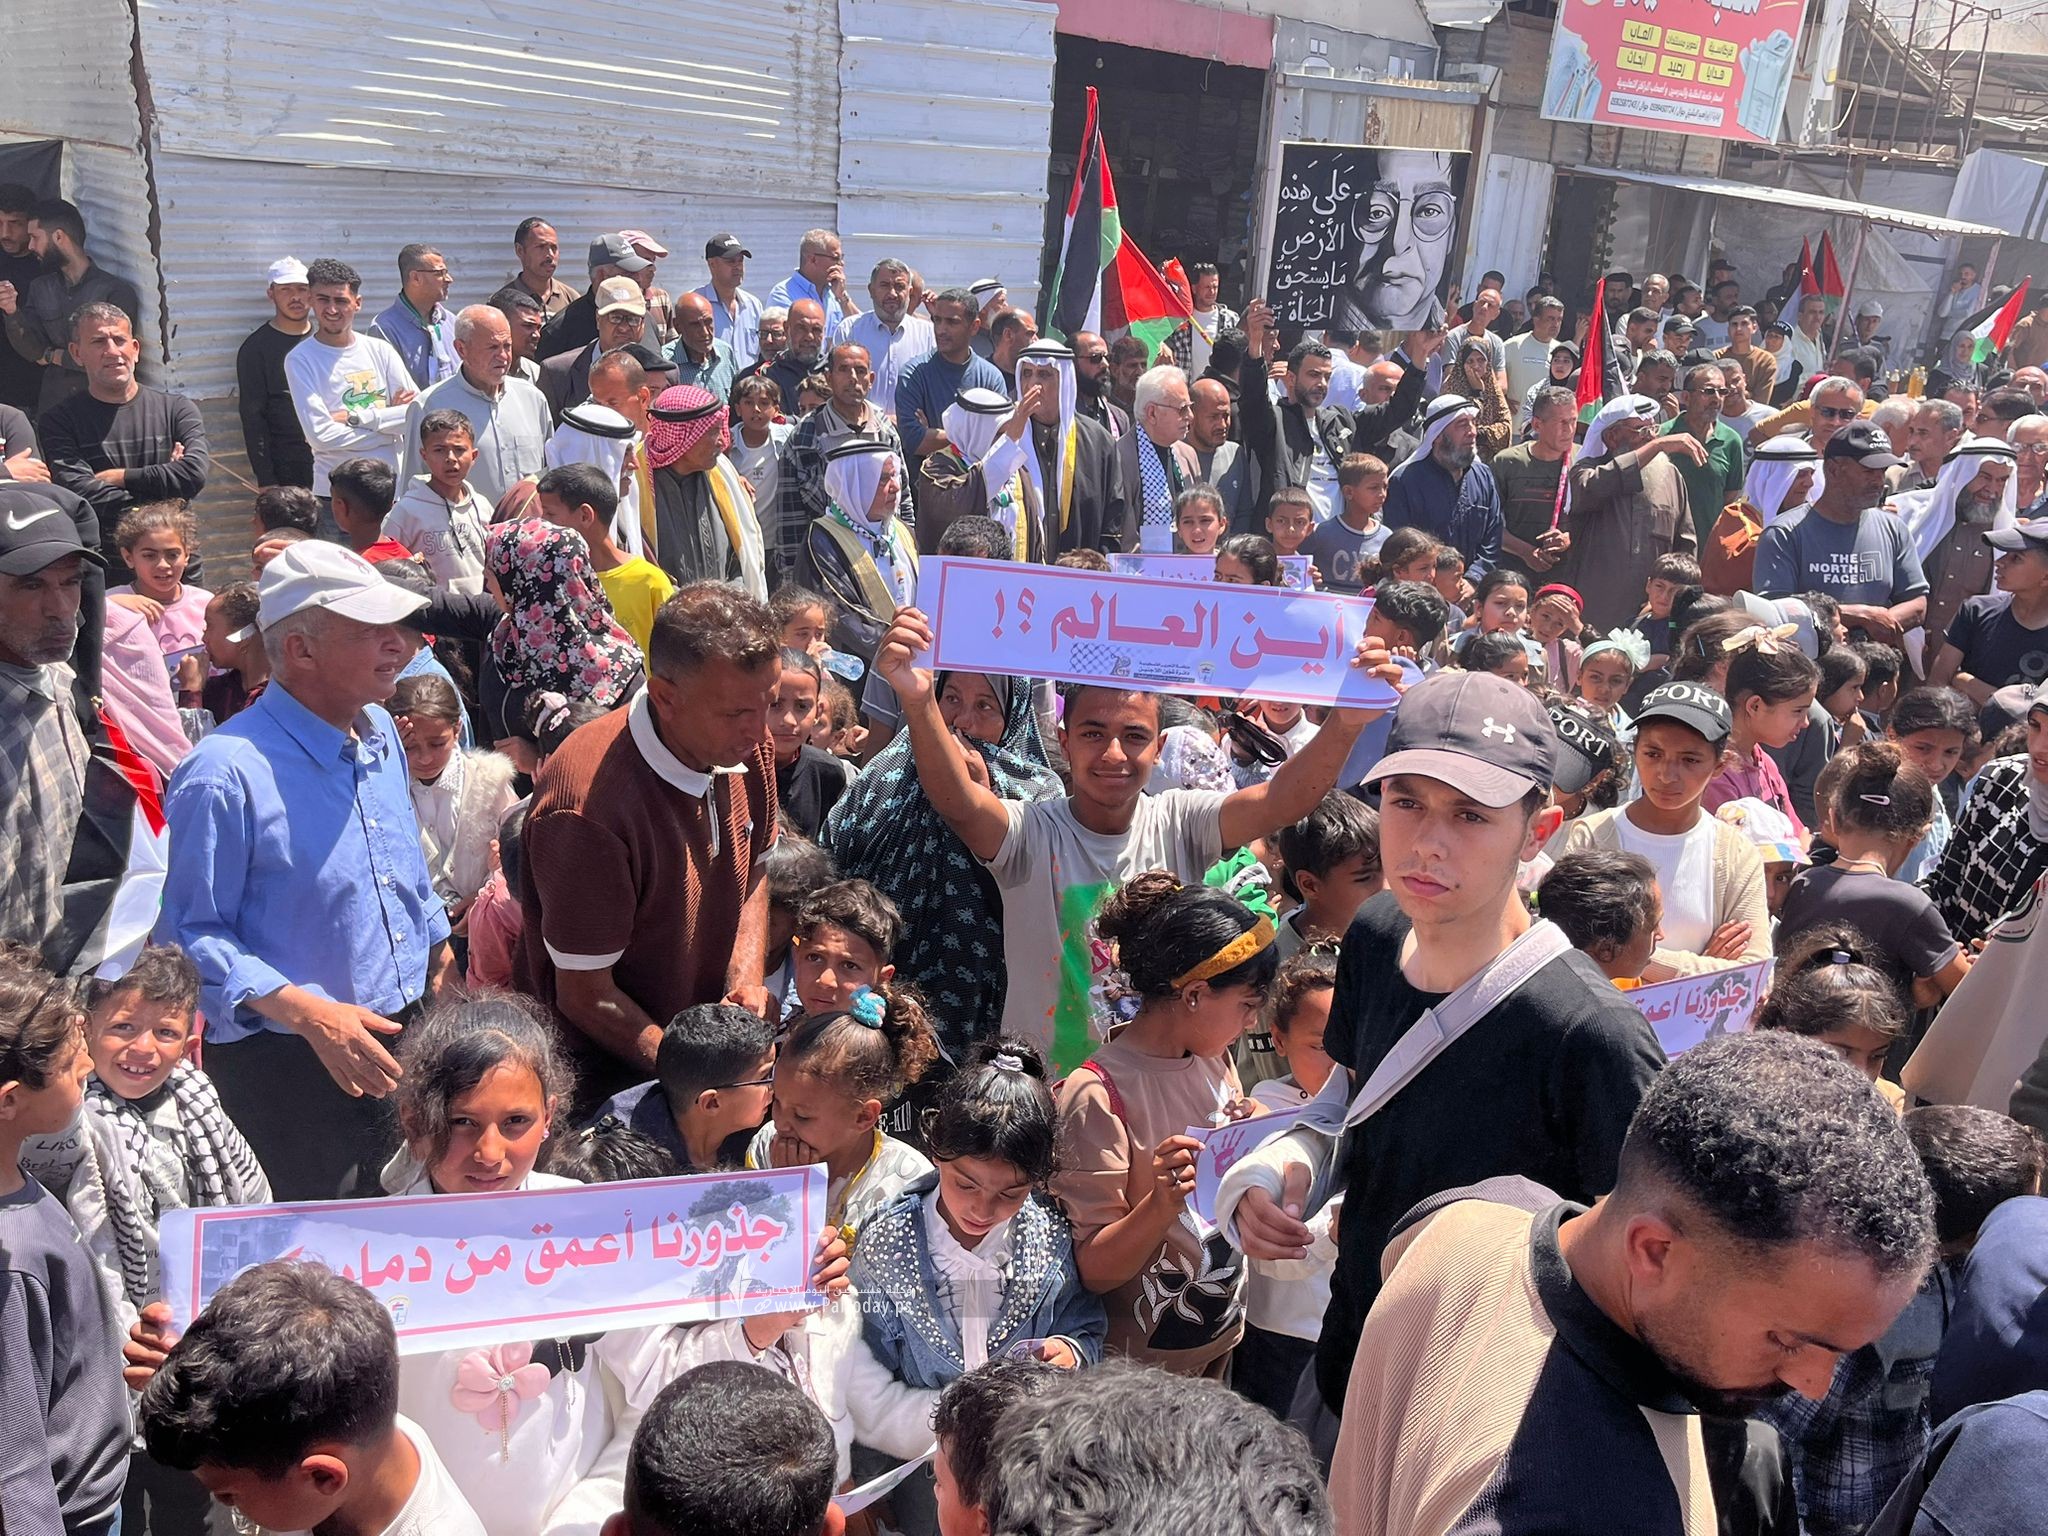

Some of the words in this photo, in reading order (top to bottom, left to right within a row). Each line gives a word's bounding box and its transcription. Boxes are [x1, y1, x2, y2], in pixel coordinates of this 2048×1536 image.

[1809, 562, 1858, 574] NORTH
[1823, 573, 1858, 584] FACE
[1830, 553, 1858, 563] THE
[1050, 588, 1219, 654] العالم
[1230, 600, 1345, 675] أين
[1684, 978, 1747, 1022] جذورنا
[524, 1208, 634, 1286] أعمق
[651, 1205, 784, 1268] جذورنا
[445, 1238, 512, 1295] من
